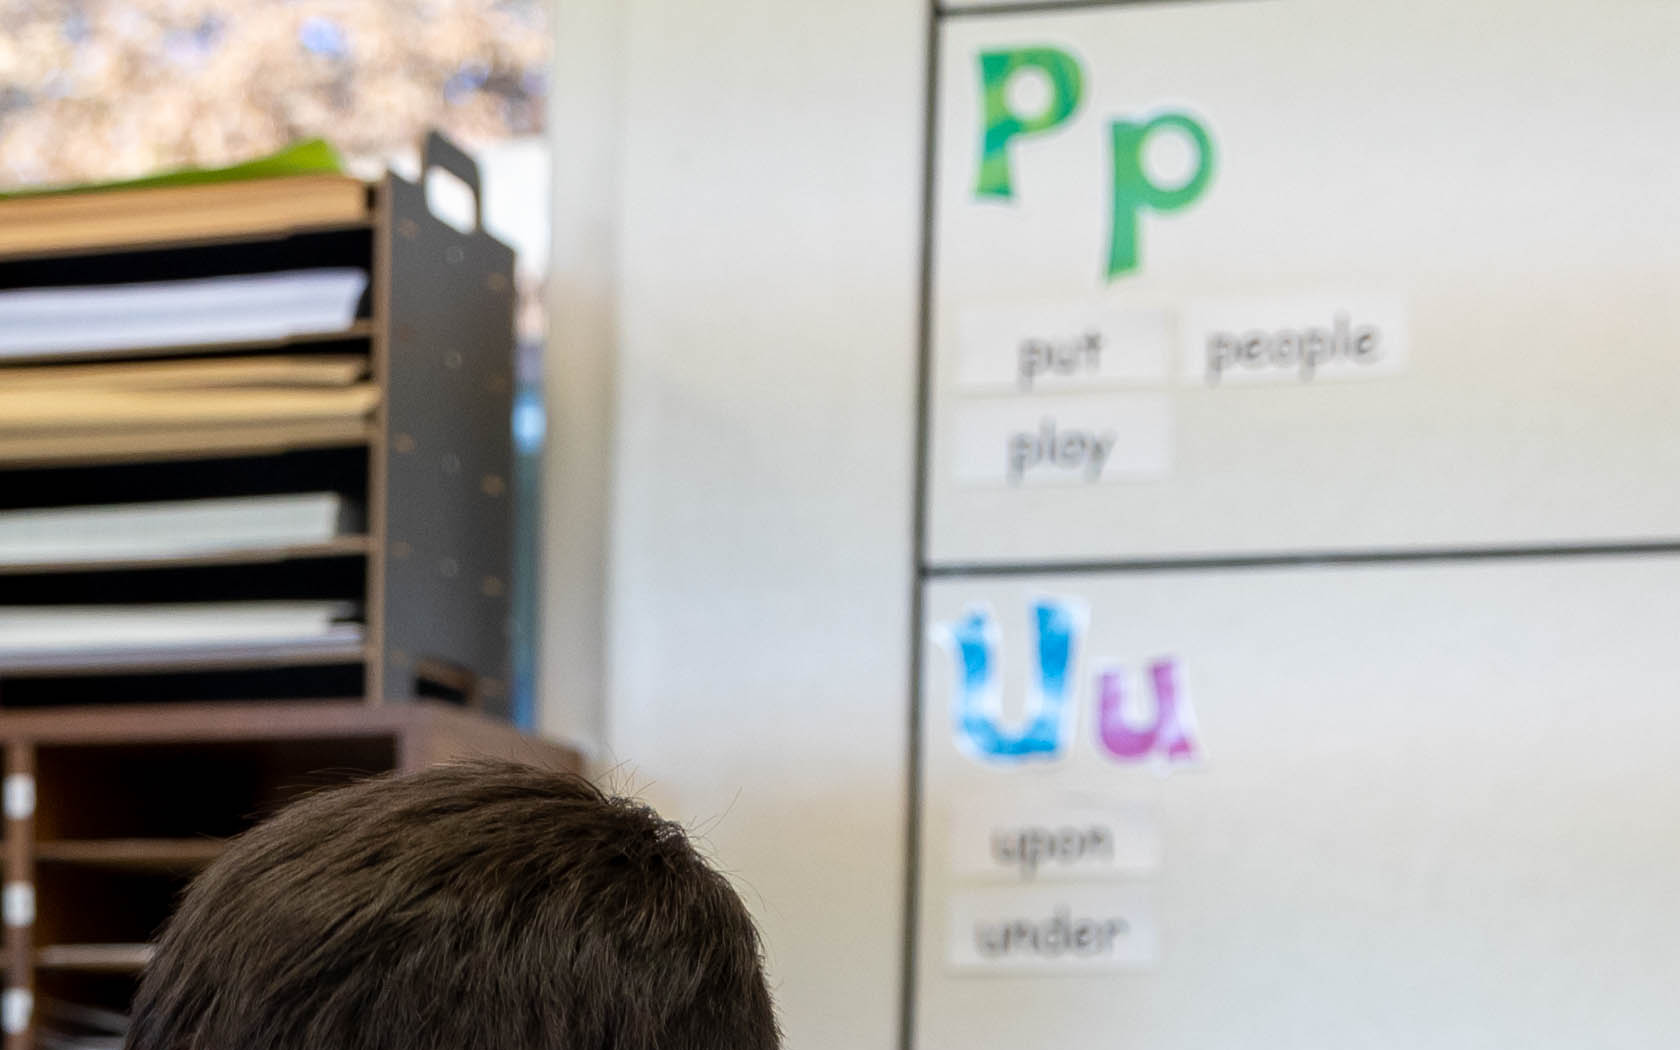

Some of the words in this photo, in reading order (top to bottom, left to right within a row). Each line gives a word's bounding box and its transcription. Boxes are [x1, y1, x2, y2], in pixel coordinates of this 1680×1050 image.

[1018, 332, 1103, 390] put
[1206, 308, 1382, 386] people
[991, 824, 1115, 880] upon
[974, 906, 1129, 958] under
